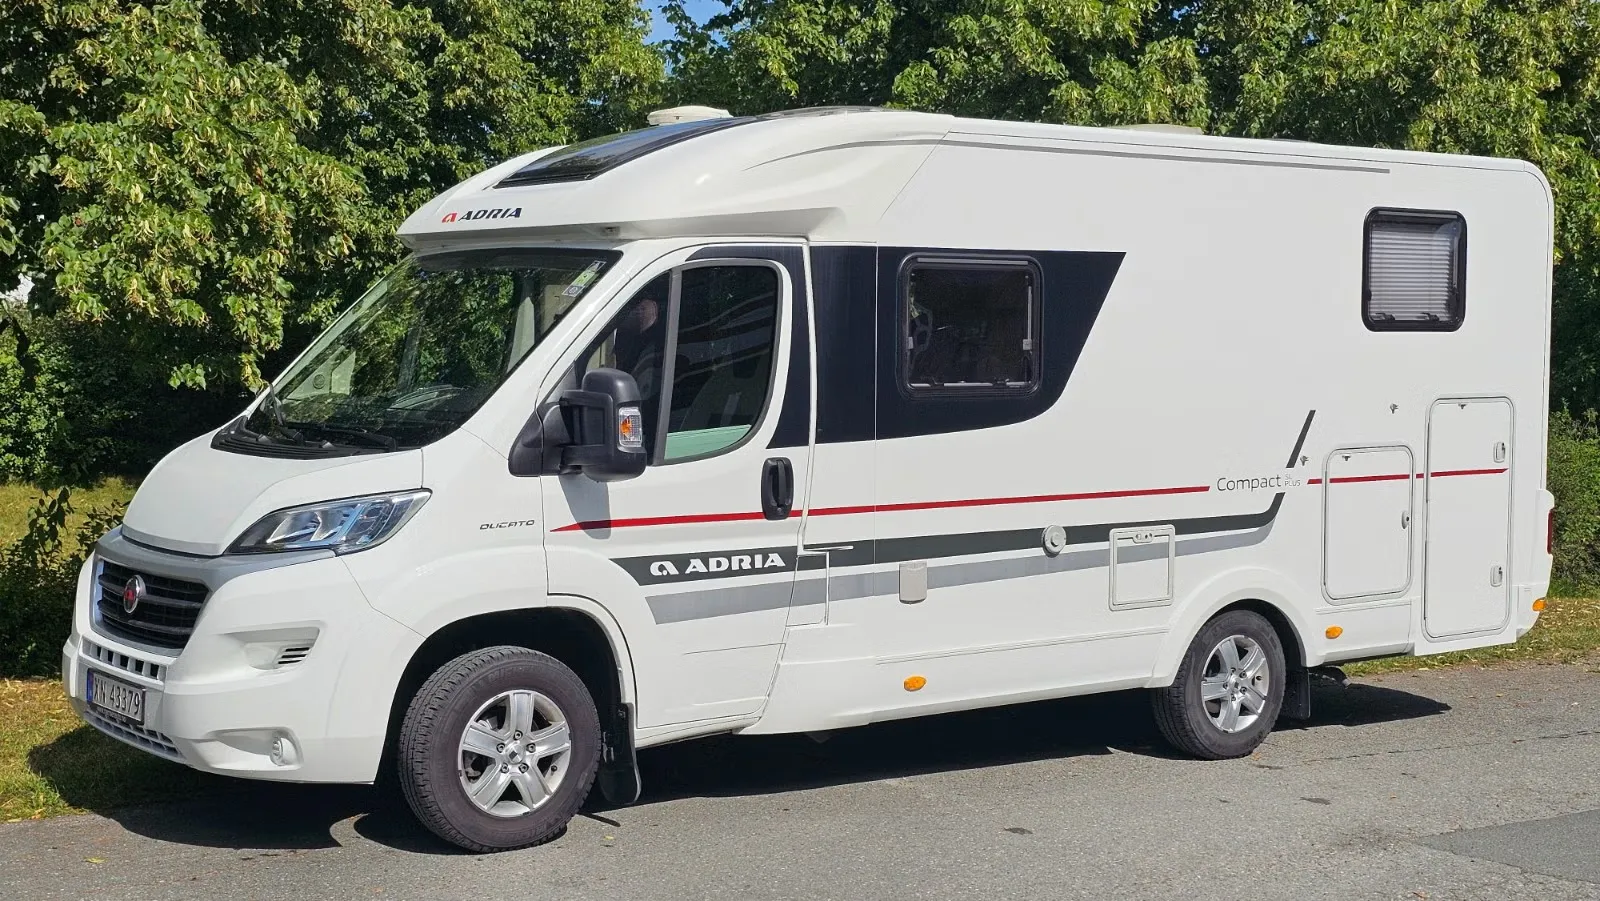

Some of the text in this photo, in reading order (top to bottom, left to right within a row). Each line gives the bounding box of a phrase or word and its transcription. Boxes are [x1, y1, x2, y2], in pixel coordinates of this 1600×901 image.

[458, 207, 522, 222] ADRIA
[1216, 474, 1282, 492] Compact
[1284, 479, 1301, 487] PLUS
[479, 519, 535, 530] DUCATO
[684, 552, 786, 575] ADRIA
[94, 677, 107, 704] XN
[110, 684, 140, 716] 43379
